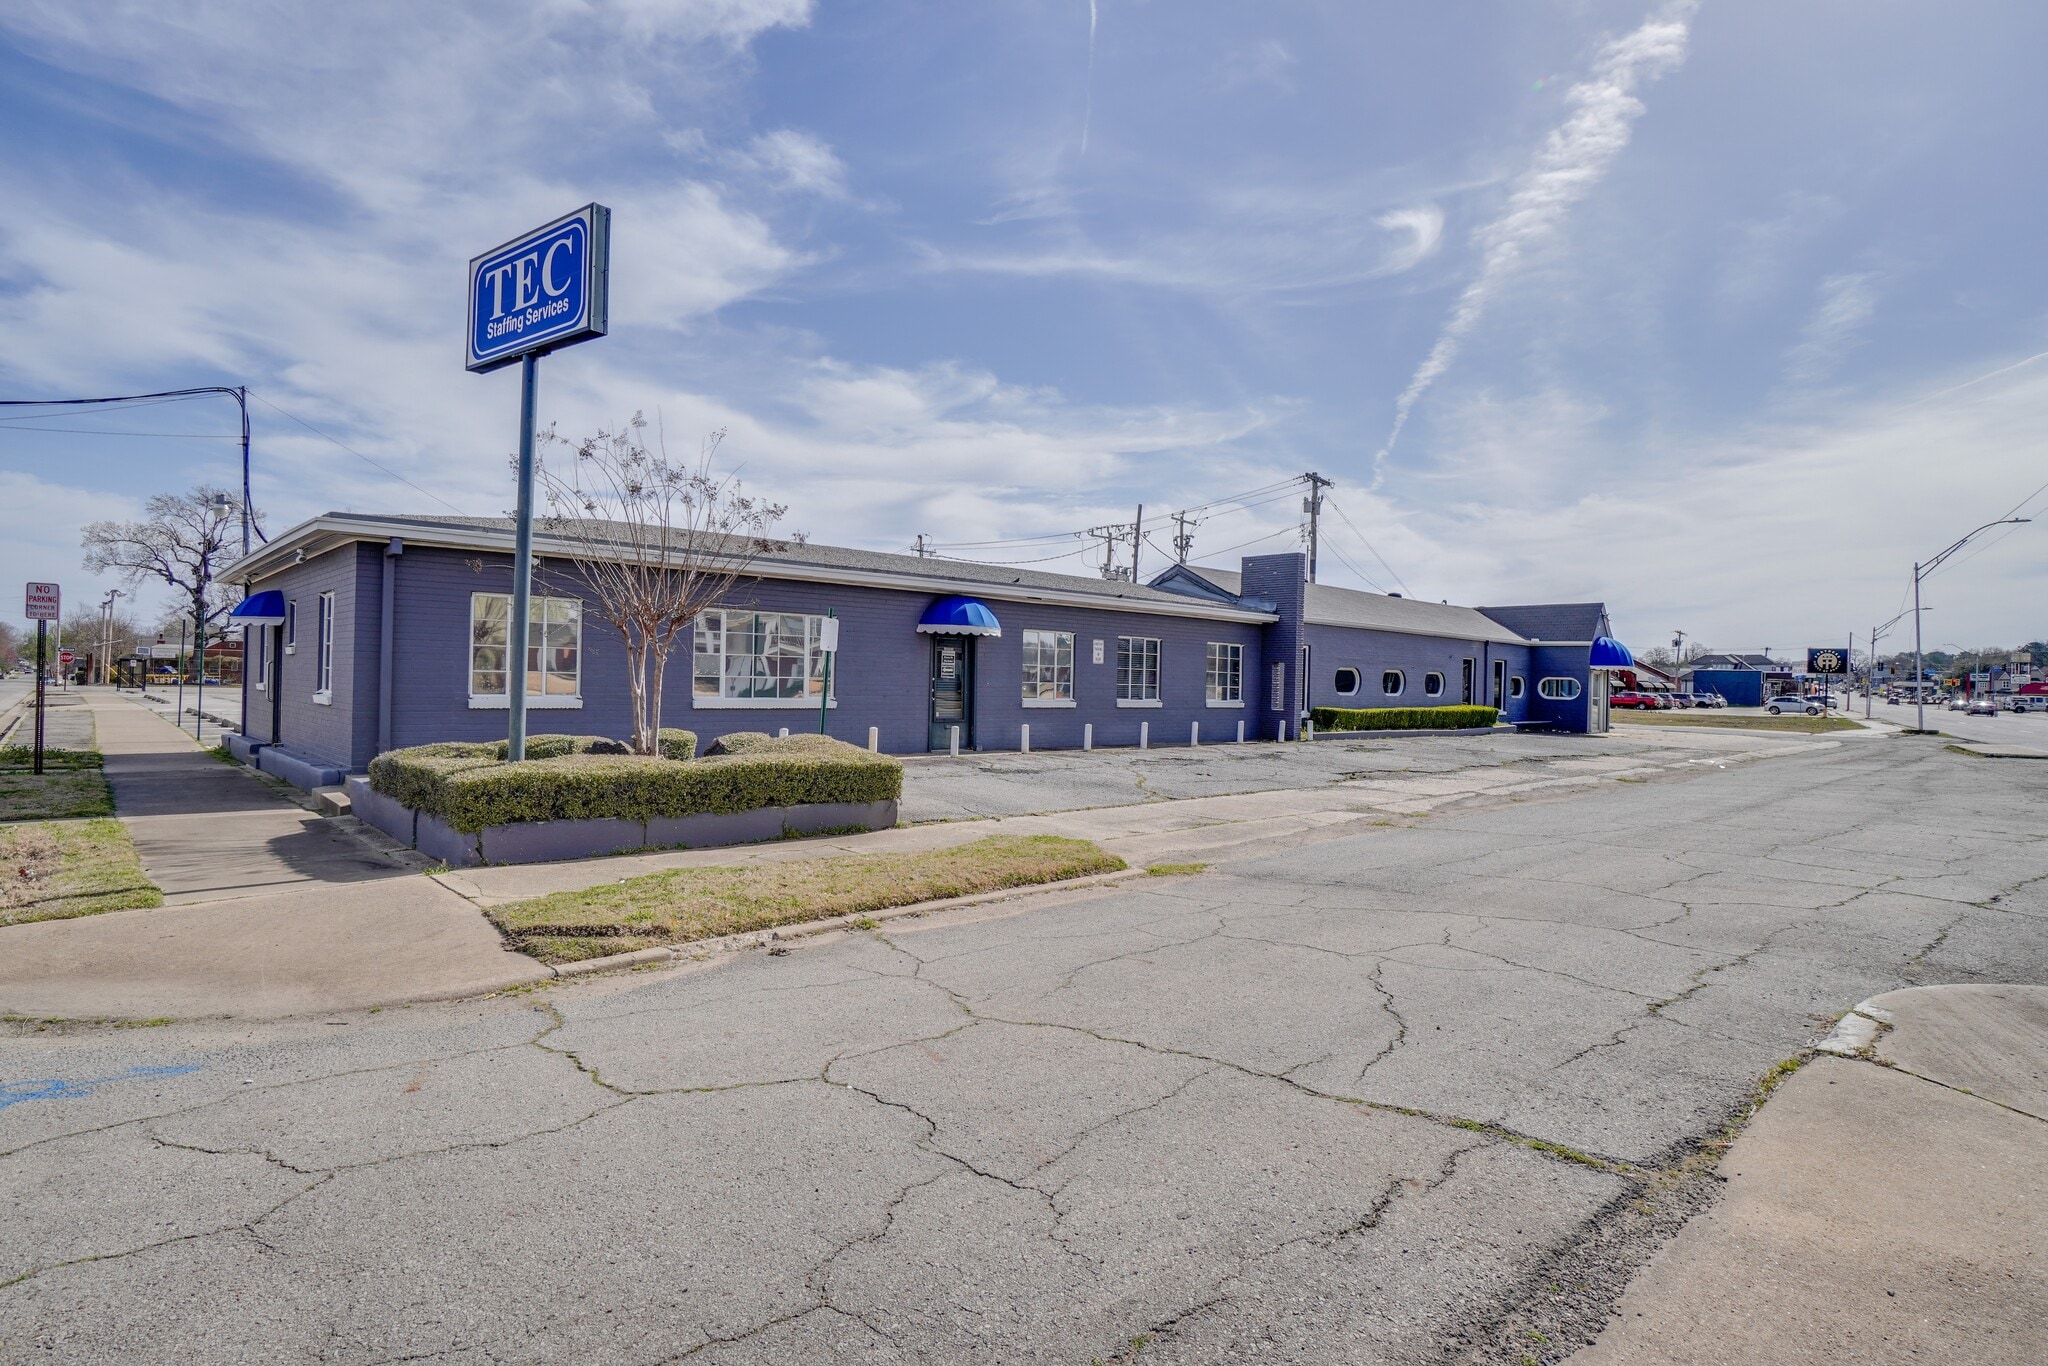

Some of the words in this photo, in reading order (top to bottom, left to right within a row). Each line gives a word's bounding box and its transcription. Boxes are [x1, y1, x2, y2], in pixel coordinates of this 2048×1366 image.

[485, 234, 573, 321] TEC
[487, 315, 523, 340] Staffing
[525, 297, 569, 326] Services
[28, 595, 57, 604] PARKING
[36, 585, 50, 594] NO
